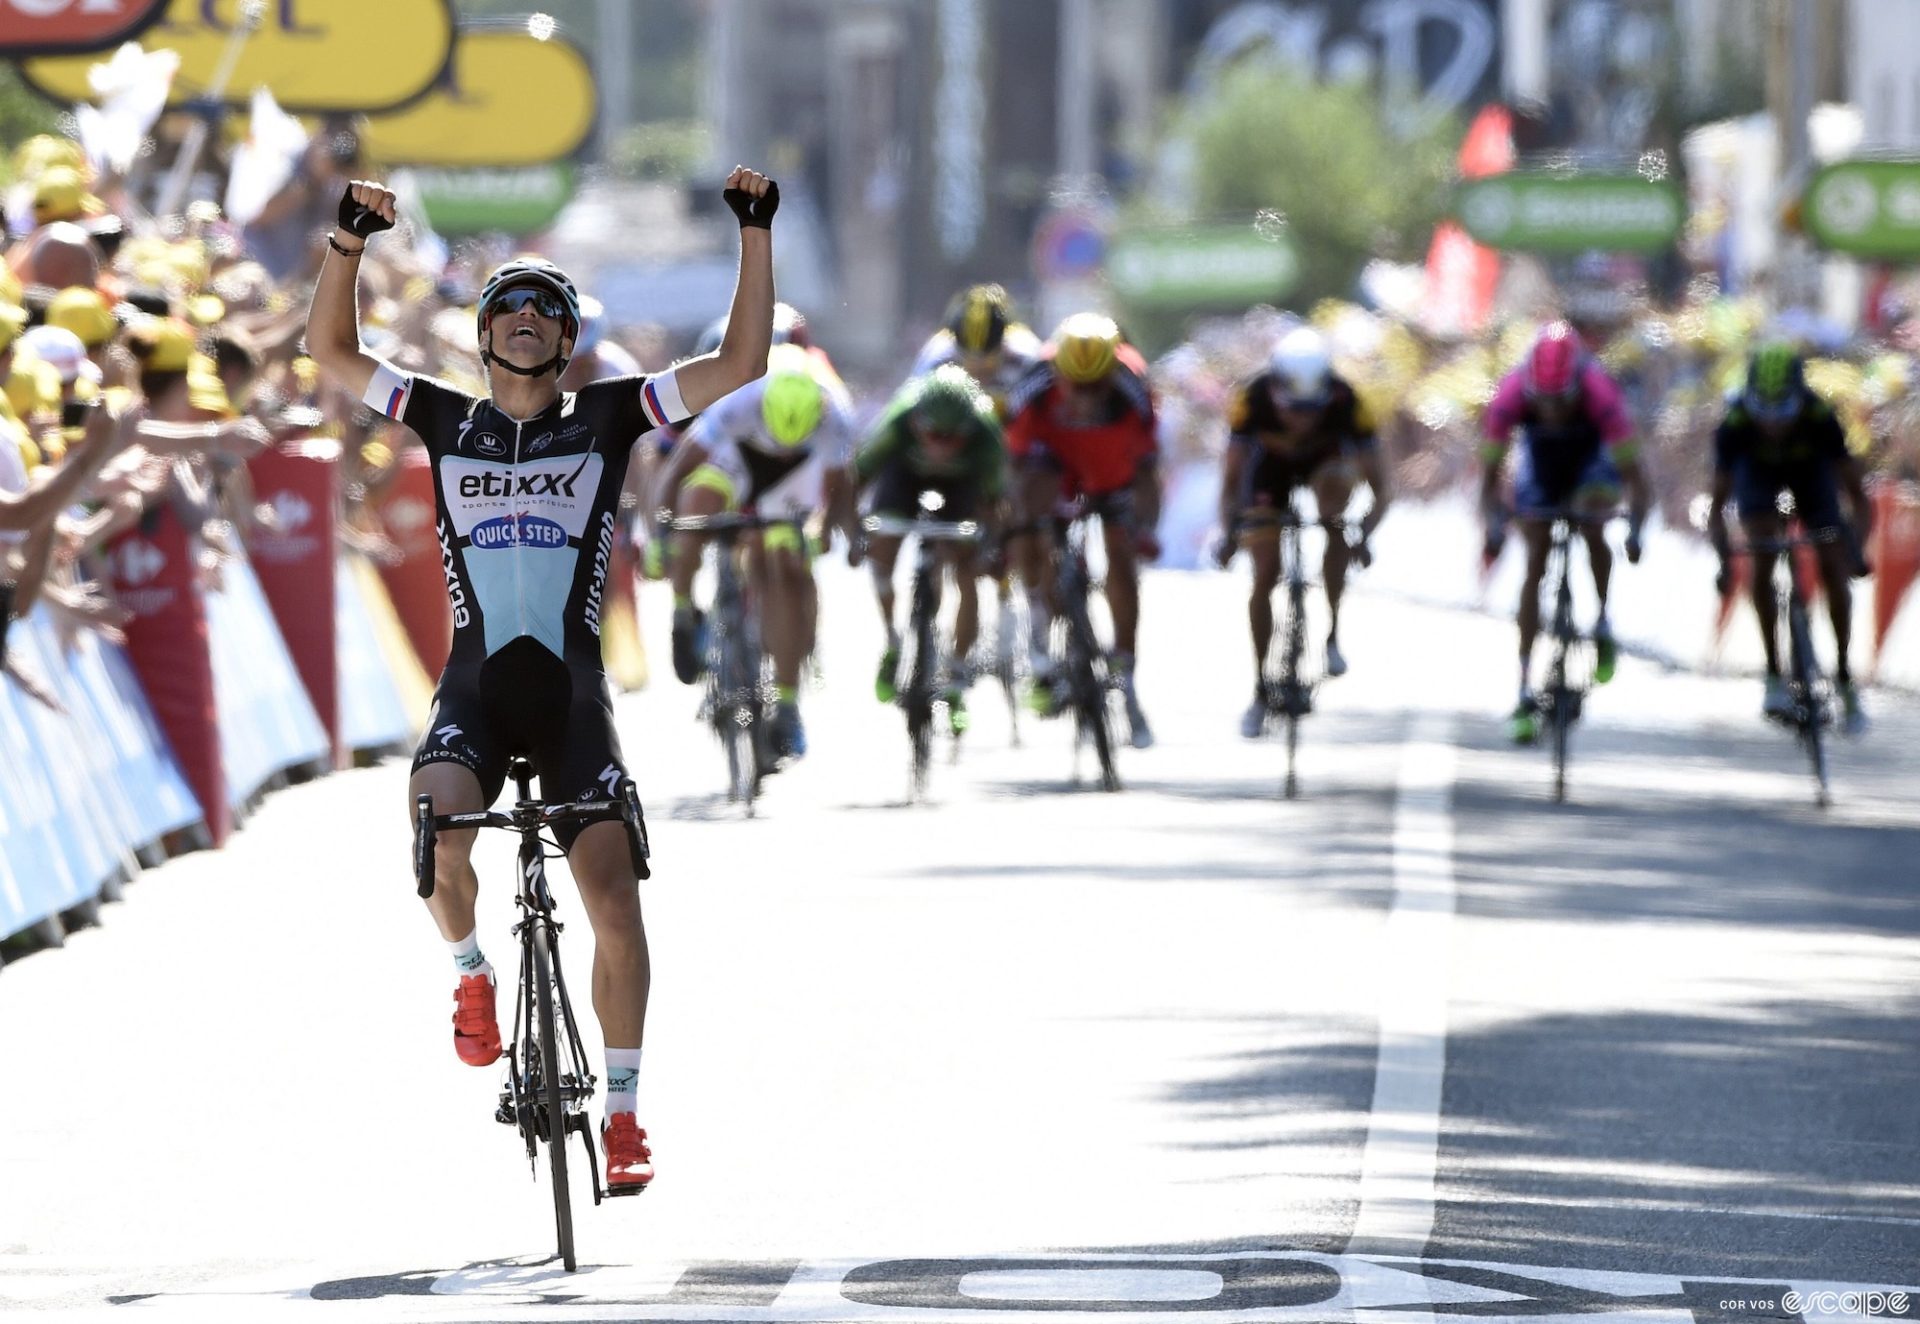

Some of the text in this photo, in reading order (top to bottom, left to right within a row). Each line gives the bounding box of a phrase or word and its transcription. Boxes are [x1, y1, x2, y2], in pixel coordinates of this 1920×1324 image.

[460, 471, 575, 498] etixx
[462, 501, 507, 509] sports
[475, 524, 562, 546] QUICK STEP
[436, 517, 470, 629] etixx
[418, 749, 476, 770] latexco
